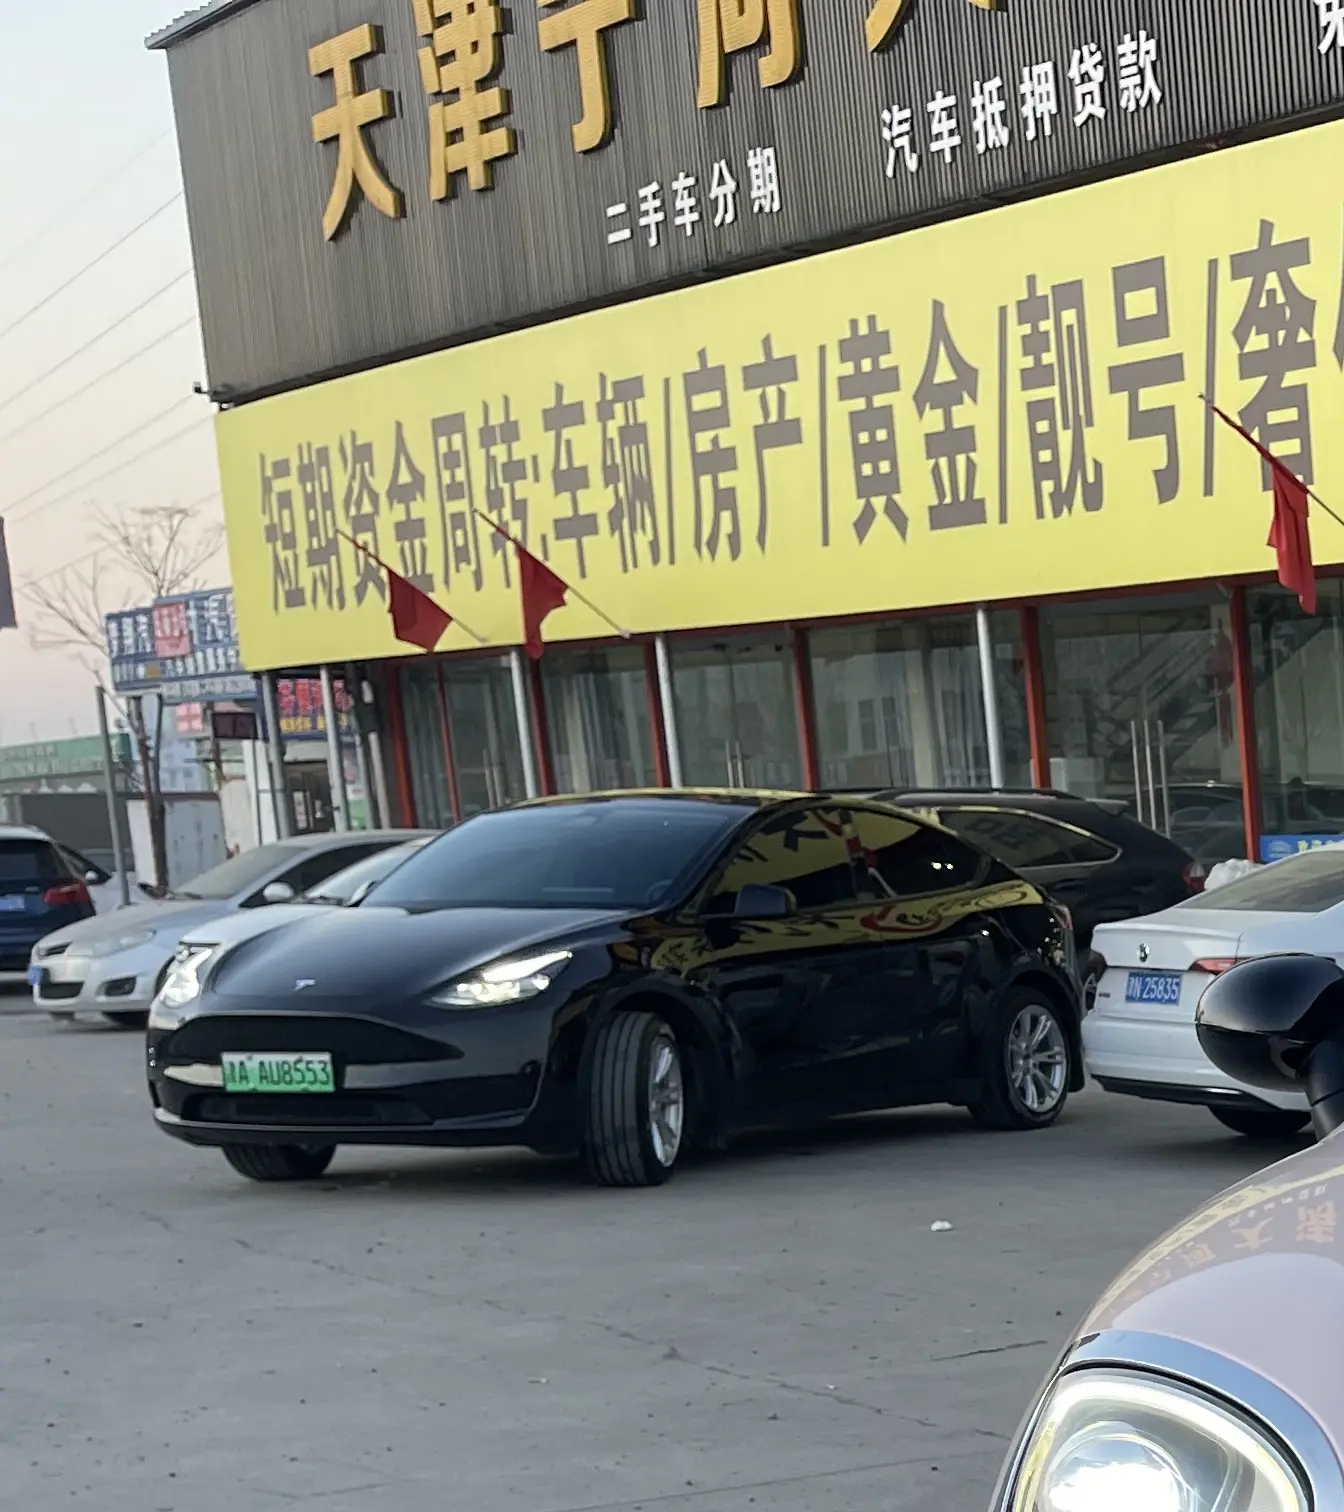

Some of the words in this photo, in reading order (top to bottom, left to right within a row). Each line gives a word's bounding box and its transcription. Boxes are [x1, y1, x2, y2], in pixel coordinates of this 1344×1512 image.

[881, 29, 1163, 179] 汽车抵押贷款
[605, 147, 782, 247] 二手车分期
[1142, 977, 1180, 1000] 25835
[259, 1057, 330, 1085] AU8553
